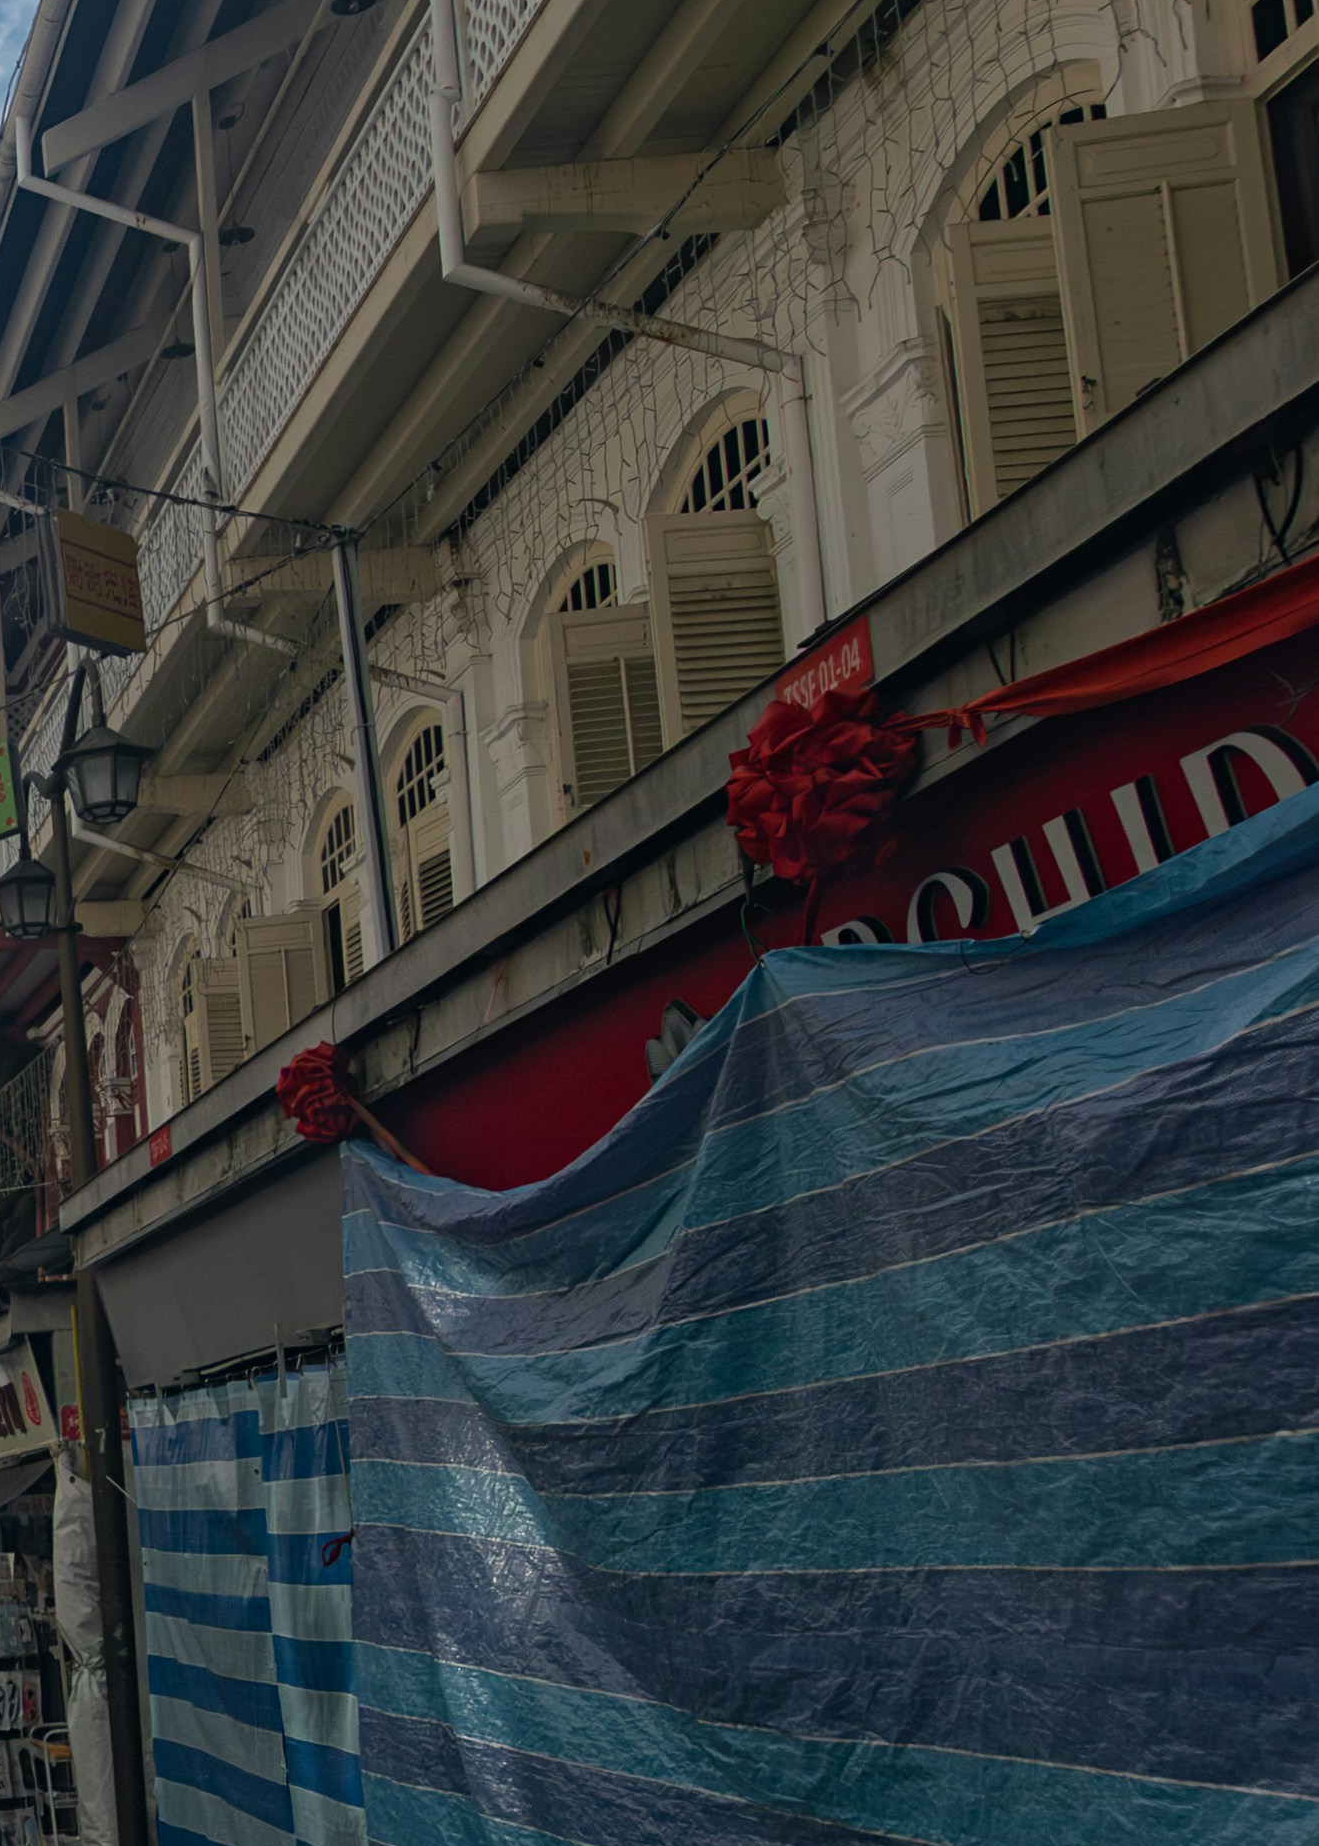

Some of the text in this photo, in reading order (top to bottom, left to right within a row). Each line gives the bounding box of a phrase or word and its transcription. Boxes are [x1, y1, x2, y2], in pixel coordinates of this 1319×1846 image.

[783, 637, 861, 708] TSSF 01-04
[95, 1428, 106, 1453] 7
